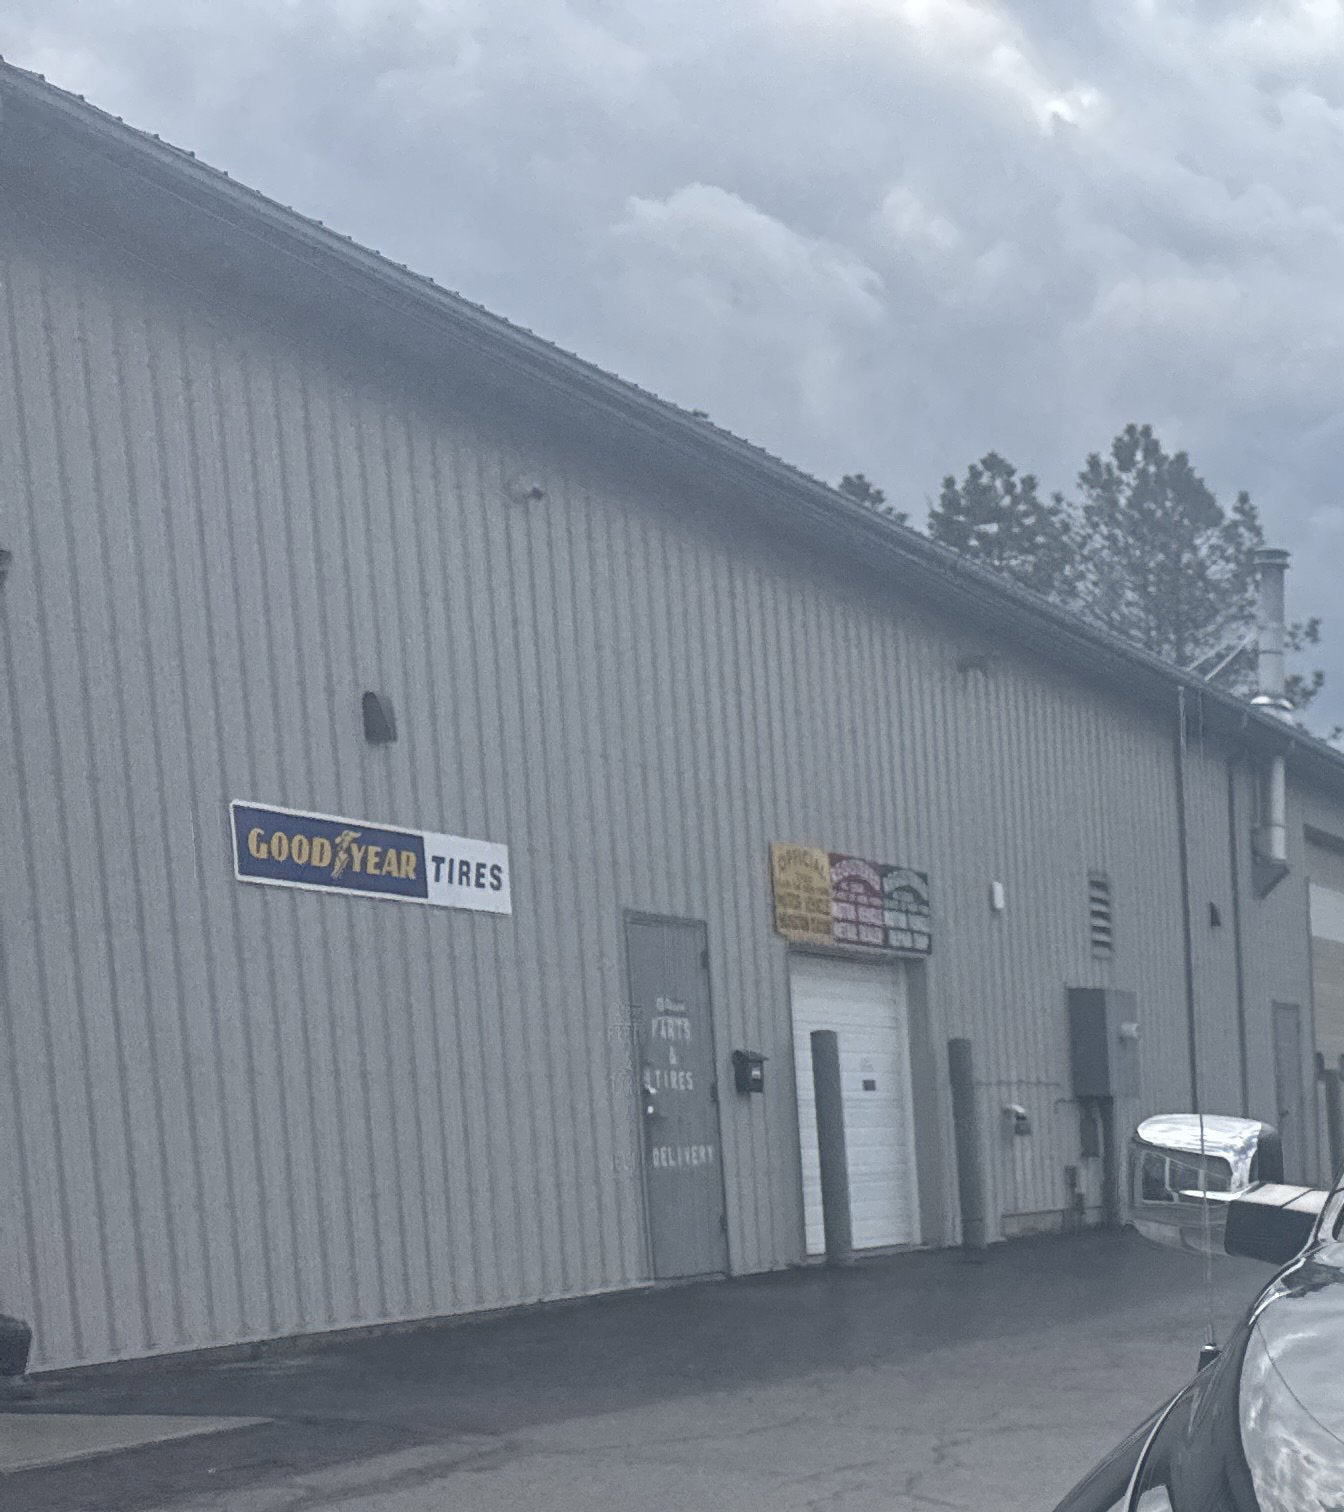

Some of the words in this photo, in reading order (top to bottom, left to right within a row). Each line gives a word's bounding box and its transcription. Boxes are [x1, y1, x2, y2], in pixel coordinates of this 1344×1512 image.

[247, 827, 417, 880] GOODYEAR
[431, 856, 503, 891] TIRES
[651, 1017, 691, 1041] PARTS
[655, 1069, 694, 1090] TIRES
[652, 1145, 713, 1168] DELIVERY
